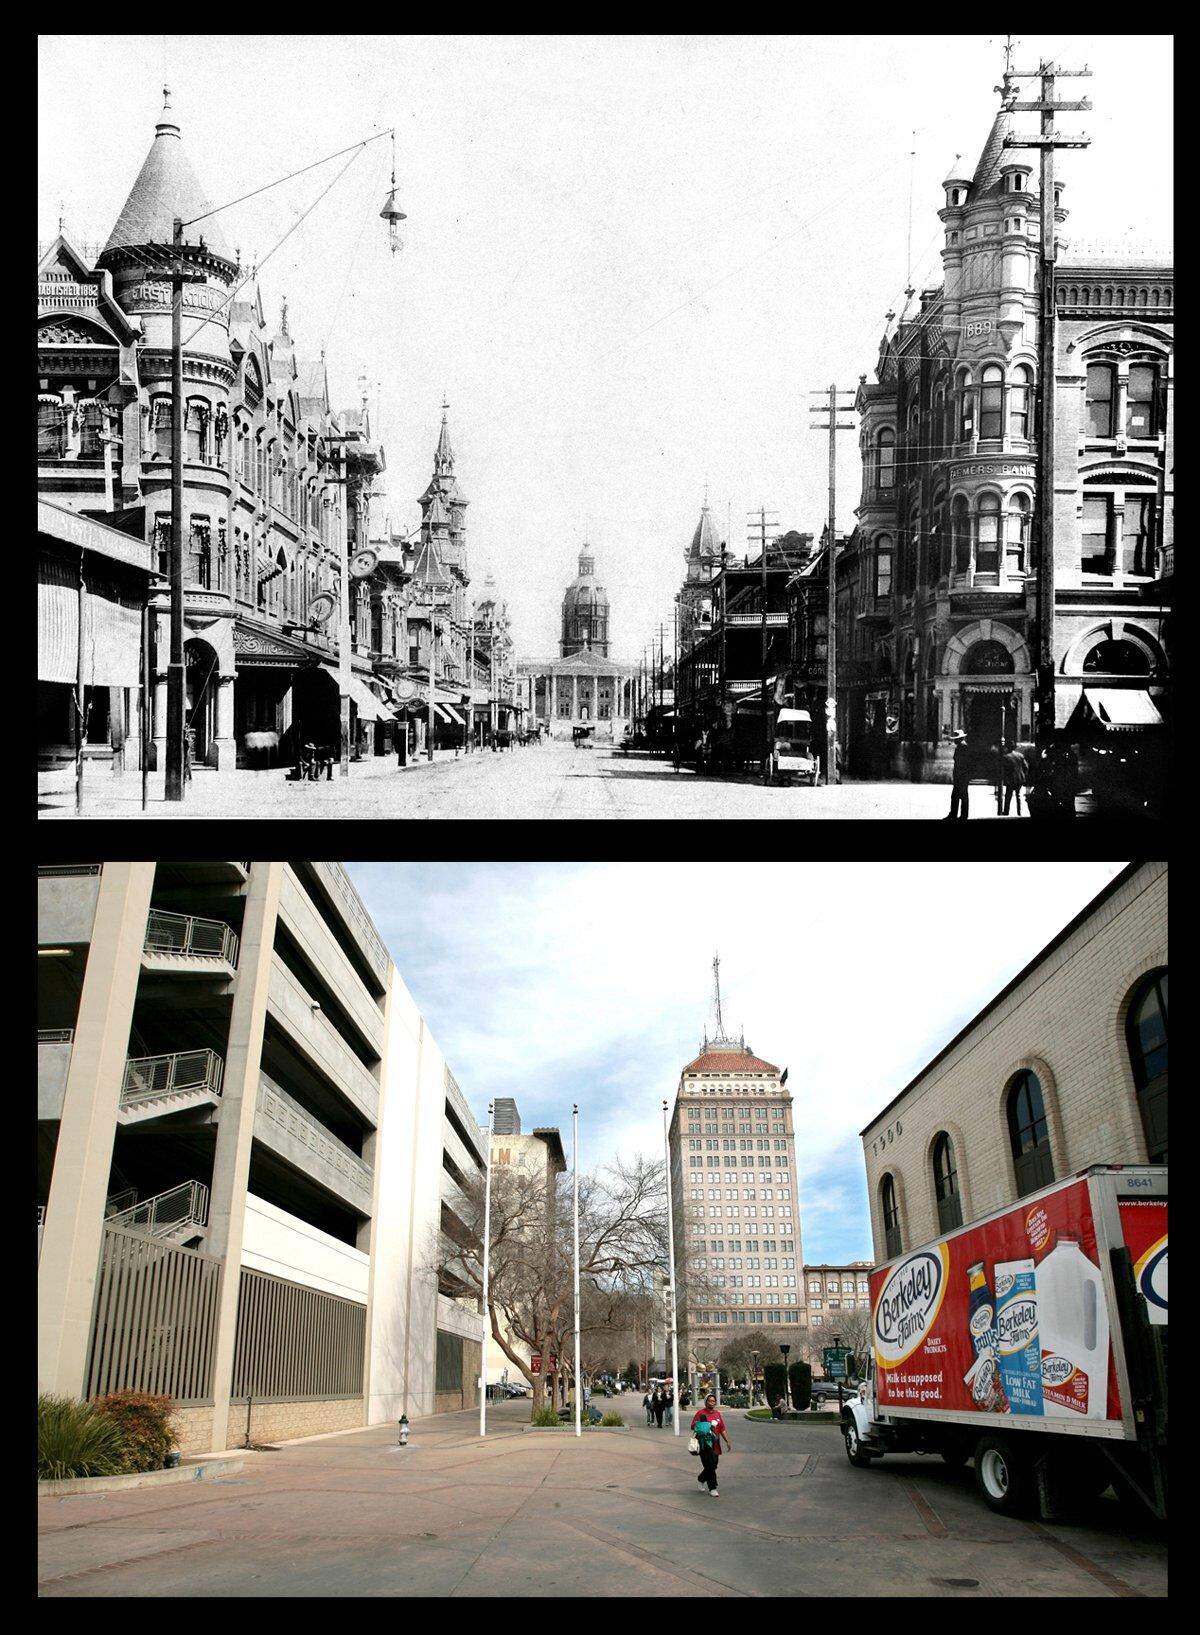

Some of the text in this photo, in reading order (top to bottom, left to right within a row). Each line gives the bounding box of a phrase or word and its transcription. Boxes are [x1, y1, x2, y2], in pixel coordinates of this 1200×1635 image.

[964, 321, 992, 339] 1889
[1127, 1178, 1152, 1187] 8641
[882, 1261, 932, 1335] Berkeley
[898, 1308, 926, 1349] Farms
[999, 1305, 1036, 1337] Berkeley
[1009, 1328, 1030, 1347] Farms
[924, 1345, 947, 1354] PRODUCTS
[1042, 1360, 1069, 1376] Berkeley
[886, 1370, 943, 1386] Milk is supposed
[1022, 1376, 1036, 1389] FAT
[888, 1387, 943, 1401] to be this good.
